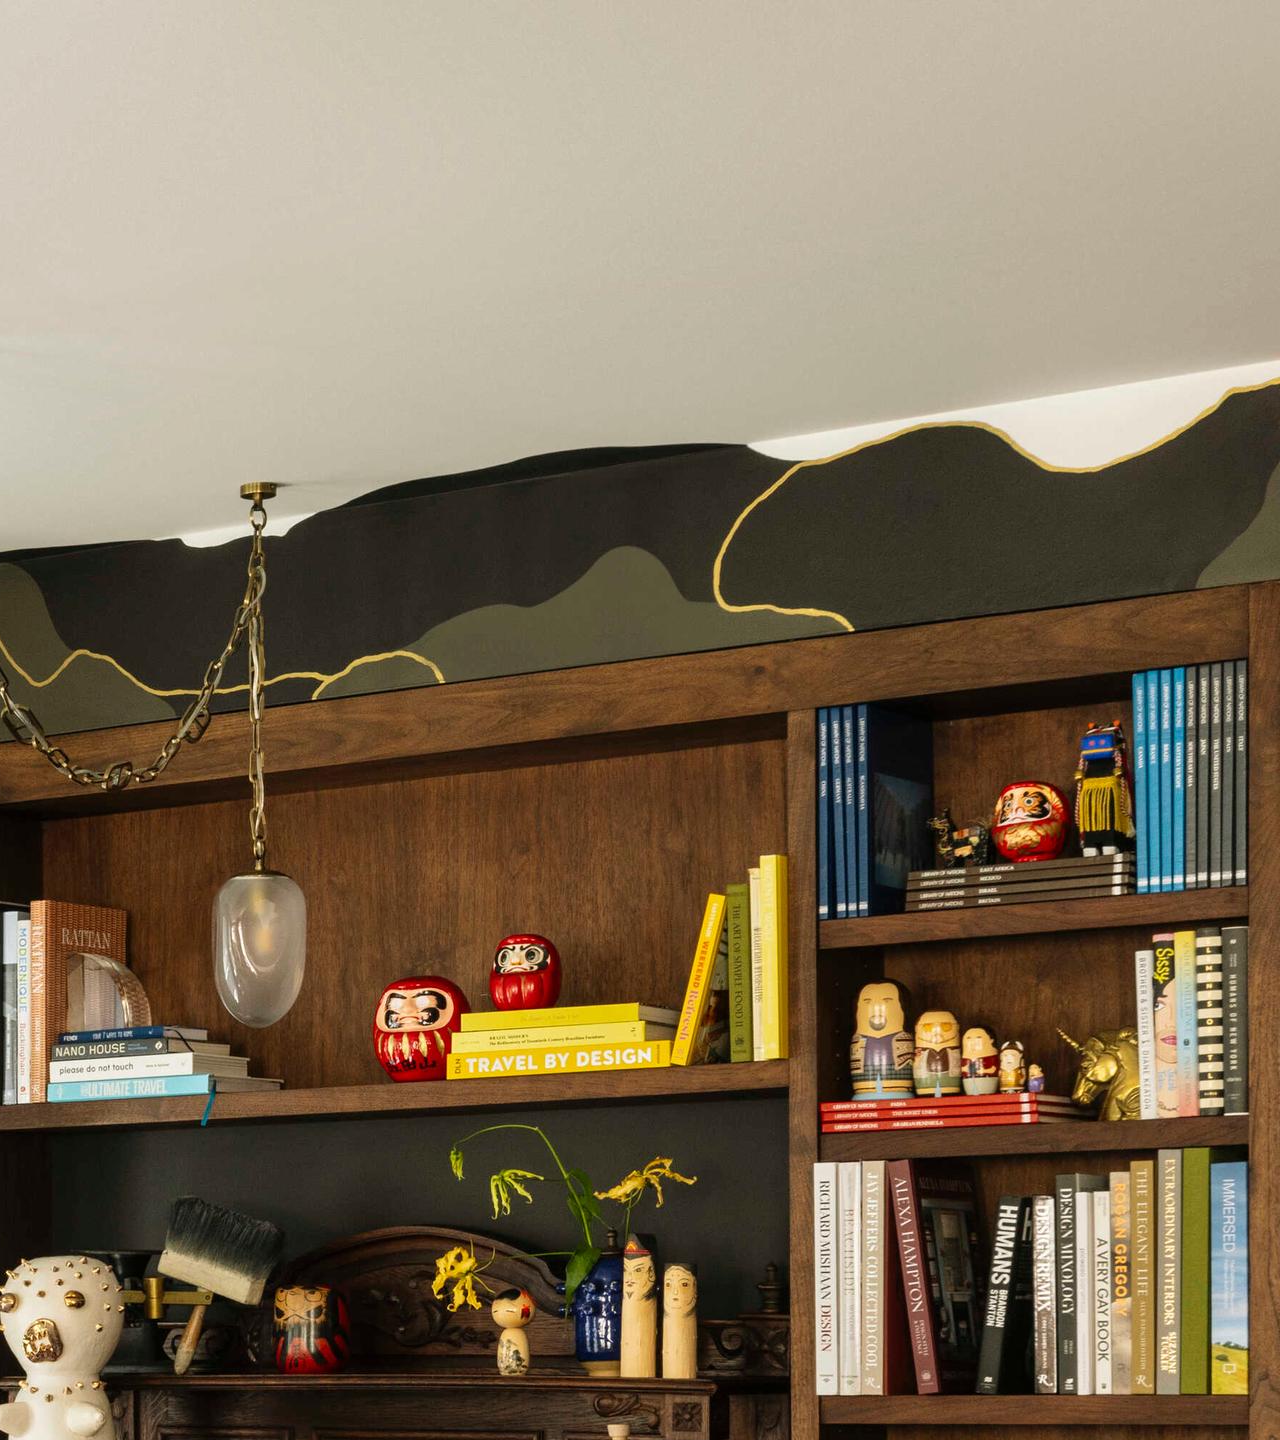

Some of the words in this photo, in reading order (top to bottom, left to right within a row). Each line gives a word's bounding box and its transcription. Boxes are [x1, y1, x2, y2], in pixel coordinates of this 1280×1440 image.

[732, 904, 741, 919] THE
[62, 928, 111, 950] RATTAN
[732, 923, 741, 940] ART
[19, 927, 27, 1013] MODERNIQUE
[31, 925, 44, 993] RATTAN
[693, 941, 710, 989] WEEKEND
[733, 956, 742, 986] SIMPLE
[1139, 957, 1147, 995] BROTHER
[1153, 948, 1174, 984] Sissy
[735, 990, 744, 1018] FOOD
[1229, 974, 1237, 1008] HUMANS
[680, 990, 698, 1041] Refresh
[1140, 1007, 1148, 1035] SISTER
[1229, 1012, 1237, 1022] OF
[18, 1023, 27, 1076] Buckingham
[55, 1046, 86, 1057] NANO
[89, 1042, 126, 1055] HOUSE
[1229, 1027, 1237, 1044] NEW
[59, 1064, 84, 1075] please
[86, 1065, 95, 1073] do
[112, 1062, 134, 1071] touch
[466, 1055, 538, 1073] TRAVEL
[544, 1053, 570, 1069] BY
[576, 1047, 652, 1067] DESIGN
[1142, 1050, 1150, 1075] DIANE
[1229, 1049, 1237, 1070] YORK
[87, 1080, 129, 1097] ULTIMATE
[133, 1079, 168, 1094] TRAVEL
[866, 1172, 878, 1195] JAY
[894, 1177, 911, 1227] ALEXA
[1136, 1168, 1146, 1197] THE
[819, 1180, 830, 1238] RICHARD
[866, 1197, 878, 1252] JEFFERS
[1059, 1188, 1072, 1239] DESIGN
[1114, 1183, 1127, 1238] ROGAN
[1164, 1159, 1176, 1260] EXTRAORDINARY
[1222, 1179, 1236, 1253] IMMERSED
[991, 1204, 1019, 1285] HUMANS
[1035, 1205, 1050, 1259] DESIGN
[1097, 1237, 1108, 1248] A
[1137, 1202, 1148, 1263] ELEGANT
[820, 1241, 831, 1300] MISHAAN
[843, 1209, 854, 1296] BEACHSIDE
[901, 1231, 924, 1313] HAMPTON
[1097, 1249, 1109, 1284] VERY
[866, 1256, 878, 1333] COLLECTED
[1037, 1265, 1051, 1312] REMIX
[1061, 1242, 1074, 1316] MIXOLOGY
[1114, 1244, 1128, 1316] GREGORY
[1138, 1268, 1148, 1296] LIFE
[1164, 1263, 1176, 1325] INTERIORS
[986, 1289, 996, 1327] STANTON
[995, 1289, 1008, 1328] BRANDON
[1098, 1288, 1109, 1317] GAY
[820, 1304, 831, 1352] DESIGN
[1098, 1320, 1110, 1362] BOOK
[865, 1335, 877, 1369] COOL
[1160, 1336, 1169, 1371] TUCKER
[1168, 1332, 1177, 1374] SUZANNE
